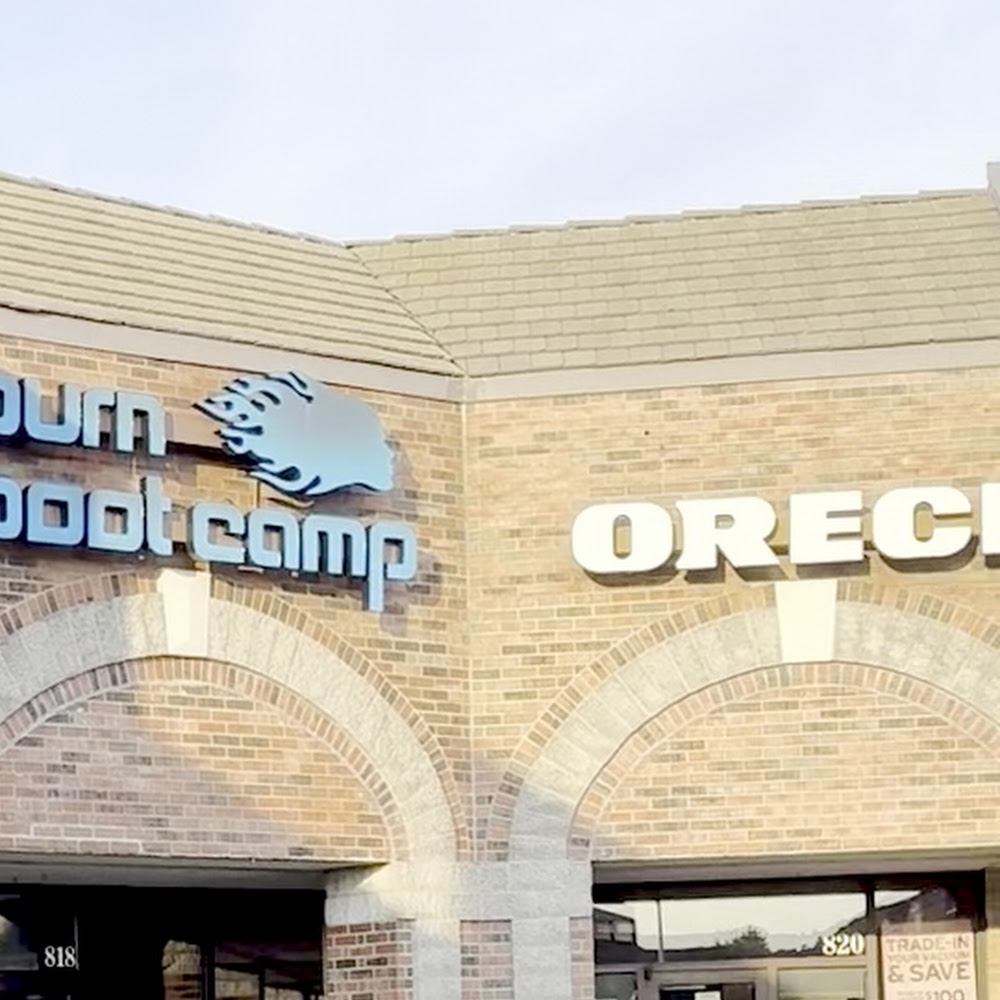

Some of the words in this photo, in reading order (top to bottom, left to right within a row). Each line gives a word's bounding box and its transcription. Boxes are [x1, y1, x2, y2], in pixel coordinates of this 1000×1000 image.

[572, 482, 1000, 574] OREC
[187, 500, 418, 612] camp
[821, 931, 865, 956] 820
[885, 936, 970, 952] TRADE-IN
[43, 945, 76, 968] 818
[887, 964, 905, 983] &
[909, 961, 971, 983] SAVE
